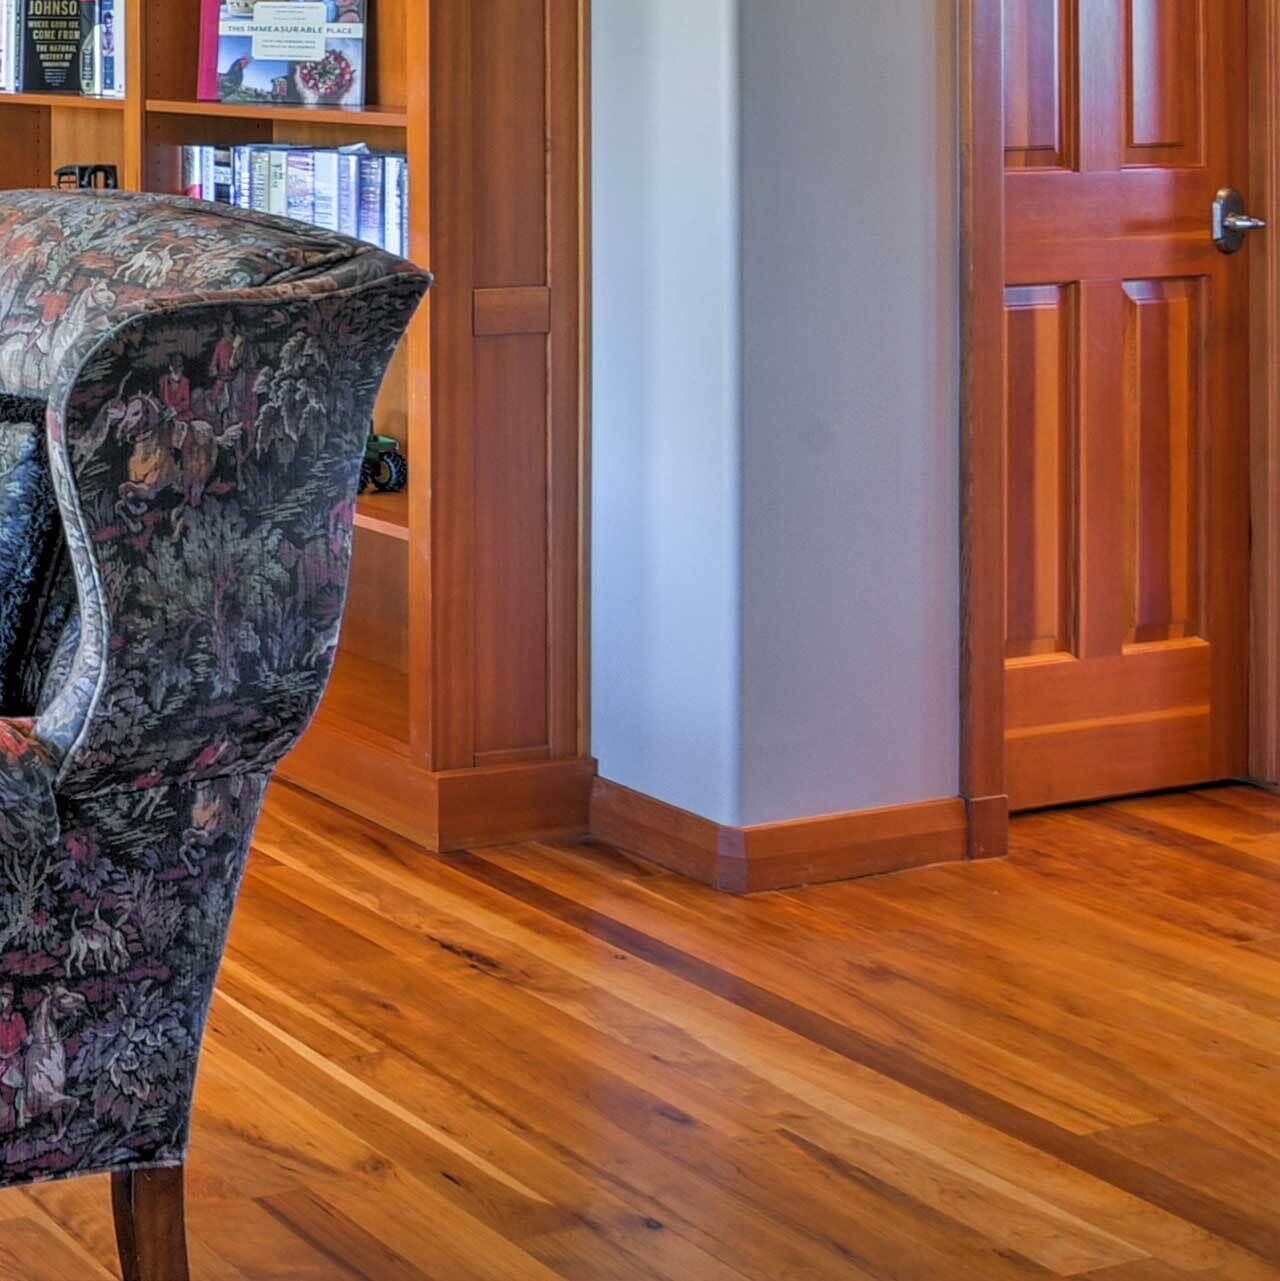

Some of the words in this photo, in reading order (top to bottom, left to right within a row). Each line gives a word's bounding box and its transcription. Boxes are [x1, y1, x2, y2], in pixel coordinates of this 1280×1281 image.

[28, 0, 80, 15] JOHNSO
[33, 30, 56, 40] COME
[58, 30, 80, 40] FROM
[246, 25, 323, 34] IMMEASURABLE
[326, 27, 353, 35] PLACE
